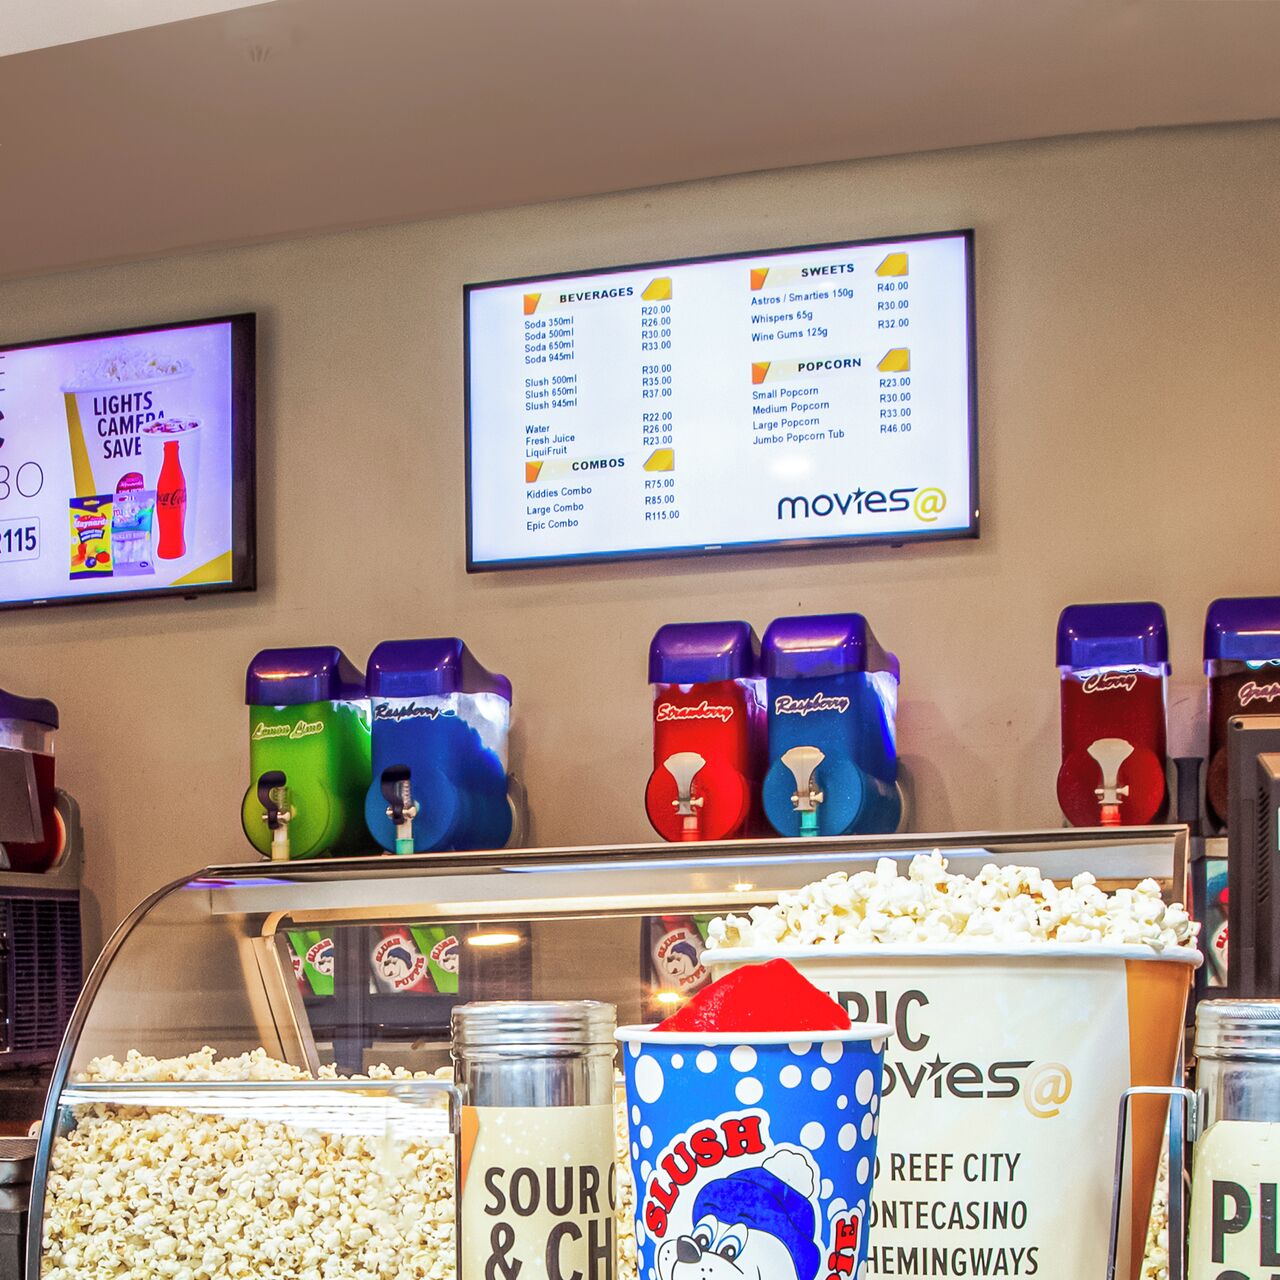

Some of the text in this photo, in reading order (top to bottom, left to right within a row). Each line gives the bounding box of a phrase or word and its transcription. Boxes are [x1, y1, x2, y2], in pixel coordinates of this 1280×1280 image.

[801, 263, 855, 278] SWEETS
[877, 281, 909, 293] R40.00
[559, 286, 634, 303] BEVERAGES
[751, 296, 781, 306] Astros
[789, 291, 829, 302] Smarties
[832, 288, 854, 299] 150g
[641, 305, 671, 316] R20.00
[877, 300, 909, 311] R30.00
[524, 316, 574, 330] Soda 350ml
[641, 317, 671, 328] R26.00
[751, 311, 813, 324] Whispers 65g
[878, 318, 909, 329] R32.00
[524, 328, 574, 341] Soda 500ml
[641, 328, 671, 340] R30.00
[751, 327, 828, 342] Wine Gums 125g
[524, 340, 574, 353] Soda 650ml
[641, 340, 671, 351] R33.00
[525, 351, 574, 364] Soda 945ml
[642, 364, 672, 375] R30.00
[798, 358, 862, 373] POPCORN
[525, 374, 577, 388] Slush 500ml
[642, 376, 672, 387] R35.00
[879, 377, 911, 388] R23.00
[525, 386, 577, 399] Slush 650ml
[642, 388, 672, 398] R37.00
[752, 387, 819, 400] Small Popcorn
[880, 392, 911, 403] R30.00
[93, 391, 153, 416] LIGHTS
[525, 398, 577, 411] Slush 945ml
[752, 401, 830, 415] Medium Popcorn
[642, 411, 673, 422] R22.00
[880, 408, 911, 418] R33.00
[525, 425, 550, 434] Water
[642, 423, 673, 434] R26.00
[752, 417, 820, 431] Large Popcorn
[880, 423, 912, 434] R46.00
[526, 433, 576, 446] Fresh Juice
[643, 435, 673, 446] R23.00
[753, 429, 845, 445] Jumbo Popcorn Tub
[103, 436, 142, 459] SAVE
[526, 445, 567, 459] LiquiFruit
[572, 457, 625, 471] COMBOS
[644, 478, 675, 490] R75.00
[526, 485, 592, 499] Kiddies Combo
[645, 494, 675, 506] R85.00
[777, 486, 947, 522] movies@
[526, 502, 584, 516] Large Combo
[645, 510, 680, 522] R115.00
[526, 518, 579, 532] Epic Combo
[775, 692, 850, 717] Raspberry
[375, 702, 439, 723] Raspberry
[891, 1153, 955, 1182] REEF
[963, 1153, 1021, 1182] CITY
[646, 1116, 766, 1238] SLUSH
[484, 1166, 601, 1217] SOUR
